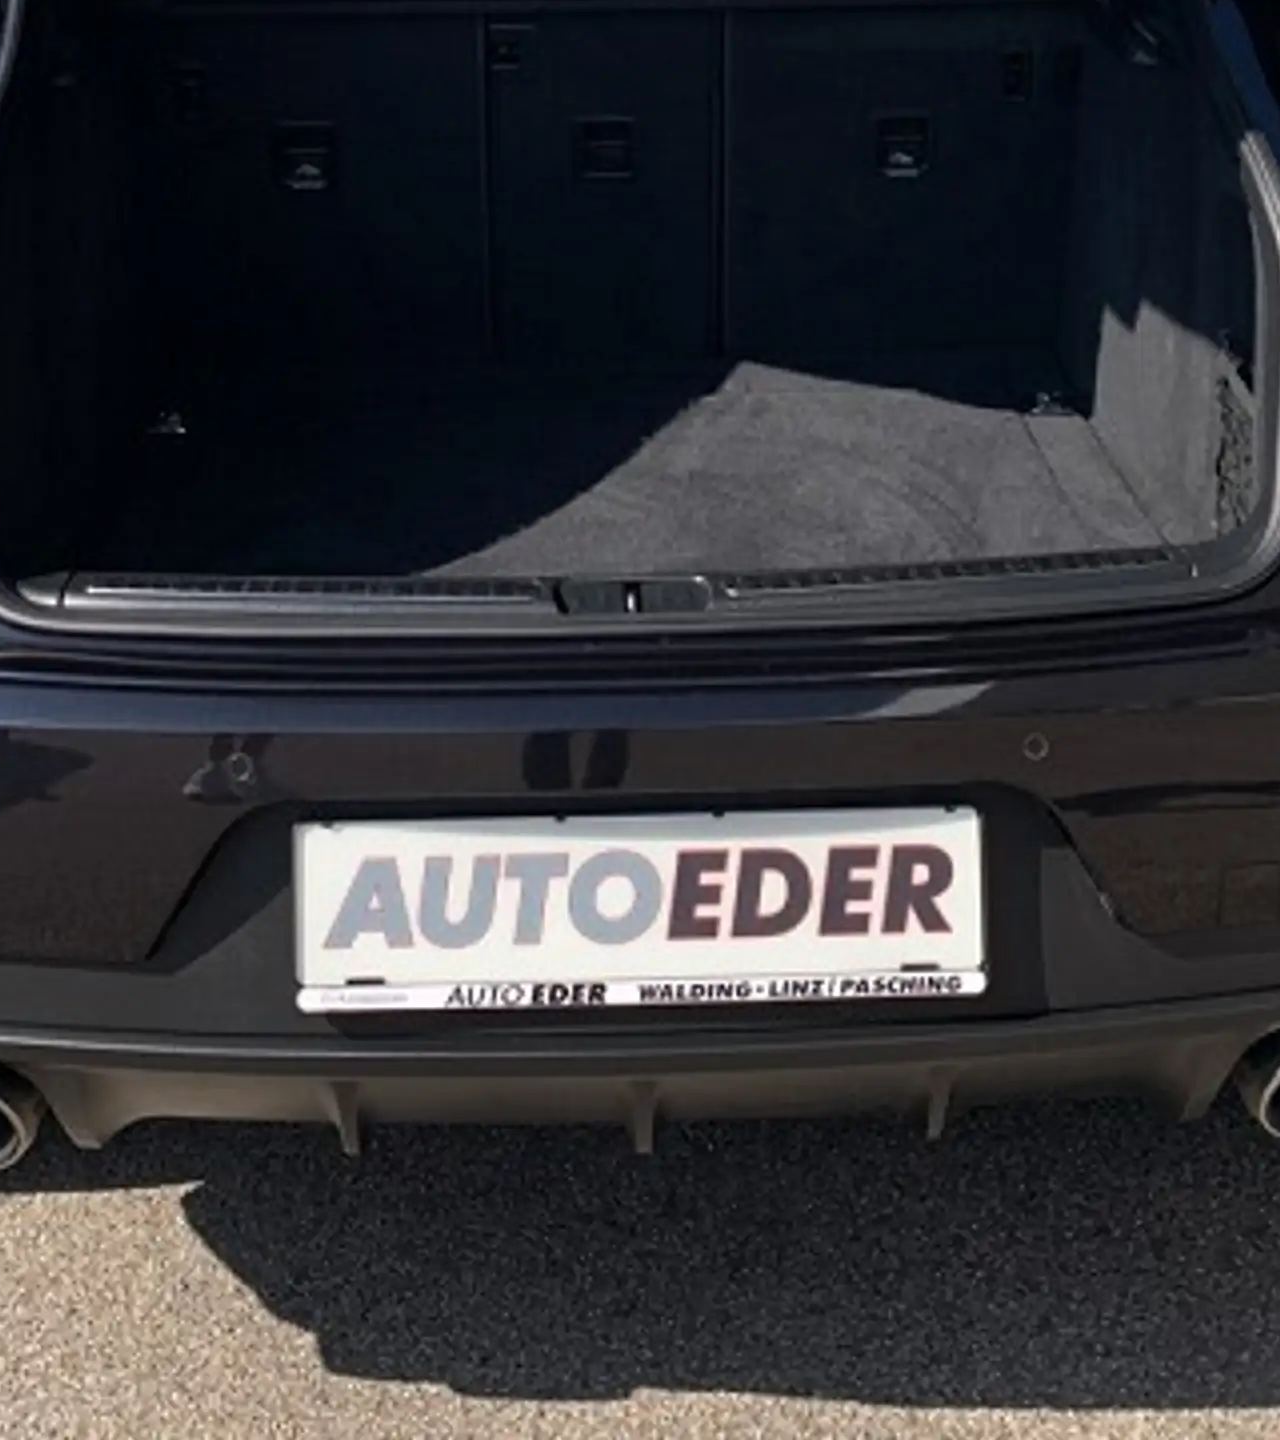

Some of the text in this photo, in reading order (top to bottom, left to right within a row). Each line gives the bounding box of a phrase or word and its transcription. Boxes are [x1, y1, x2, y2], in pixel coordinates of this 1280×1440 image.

[322, 843, 954, 951] AUTOEDER
[444, 983, 524, 1007] AUTO
[531, 982, 608, 1006] EDER
